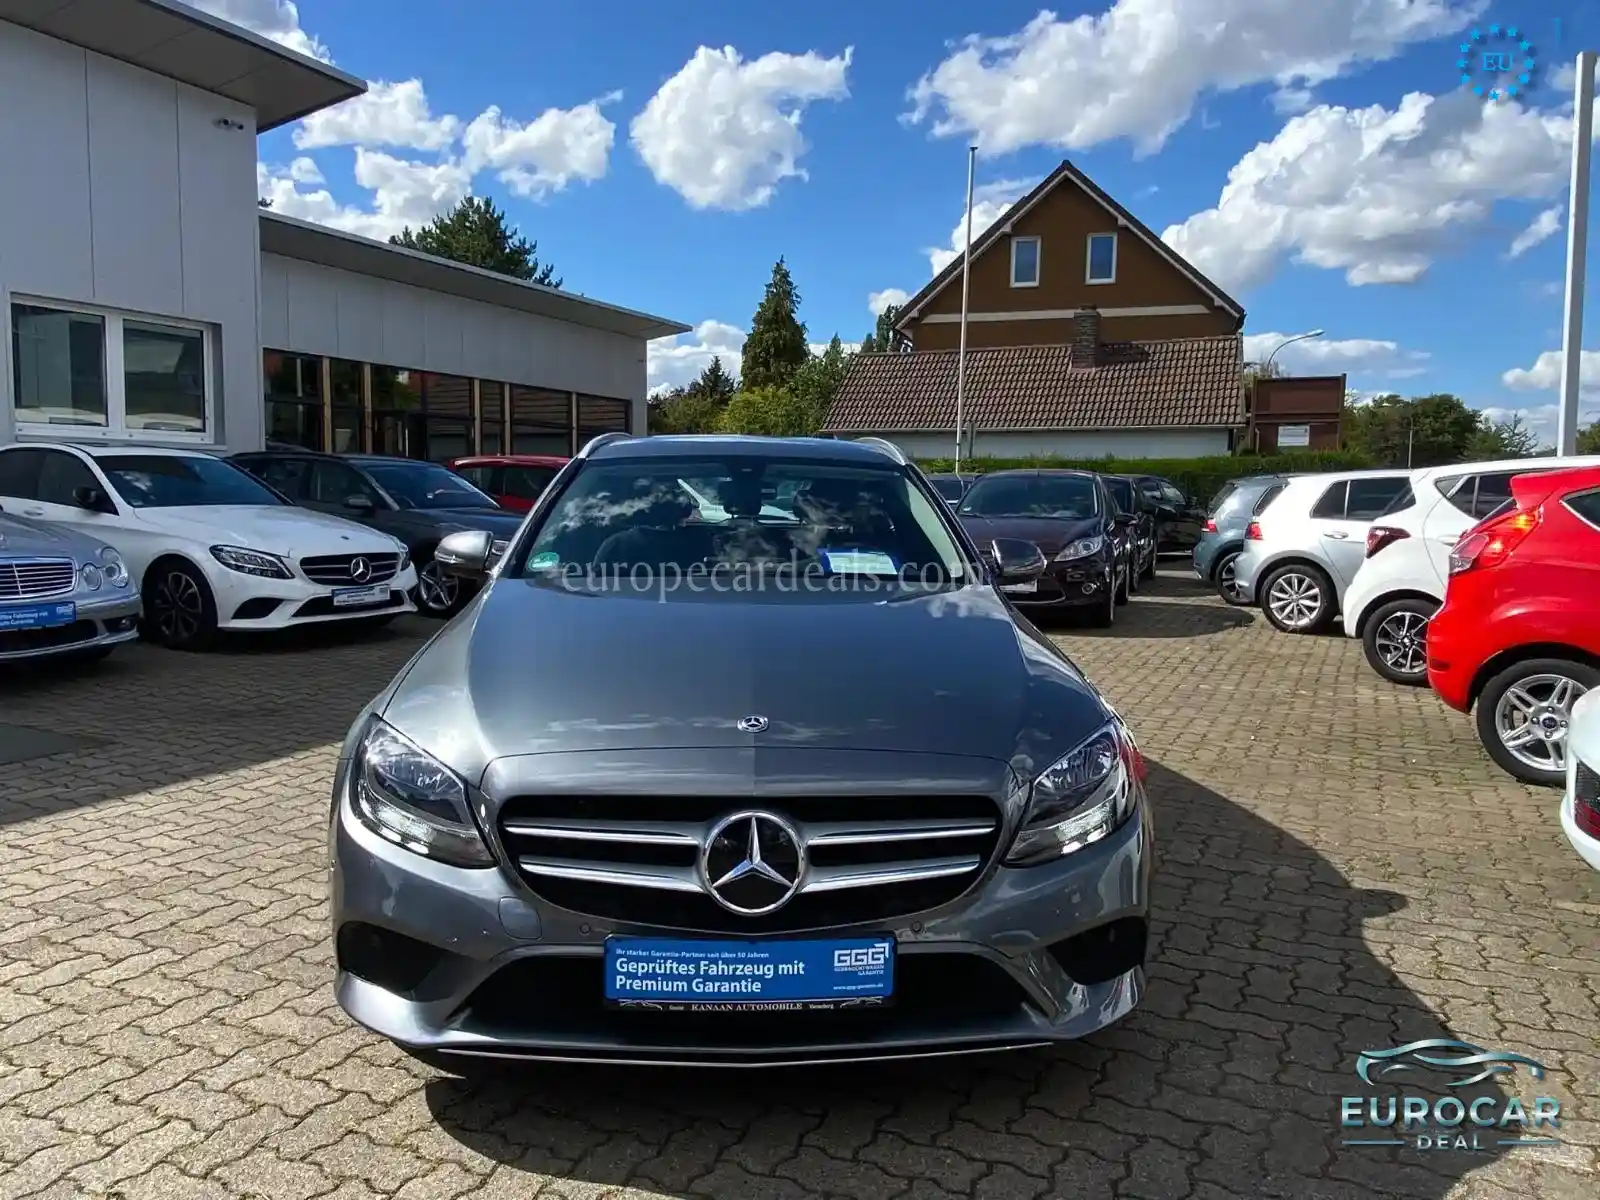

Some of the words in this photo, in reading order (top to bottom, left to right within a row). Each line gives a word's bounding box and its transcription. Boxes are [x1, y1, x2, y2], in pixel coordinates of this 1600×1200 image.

[616, 957, 696, 976] Geprüftes
[700, 960, 774, 979] Fahrzeug
[778, 960, 805, 975] mit
[616, 975, 688, 992] Premium
[692, 978, 761, 993] Garantie
[691, 1003, 733, 1011] KANAAN
[736, 1002, 803, 1011] AUTOMOBILE
